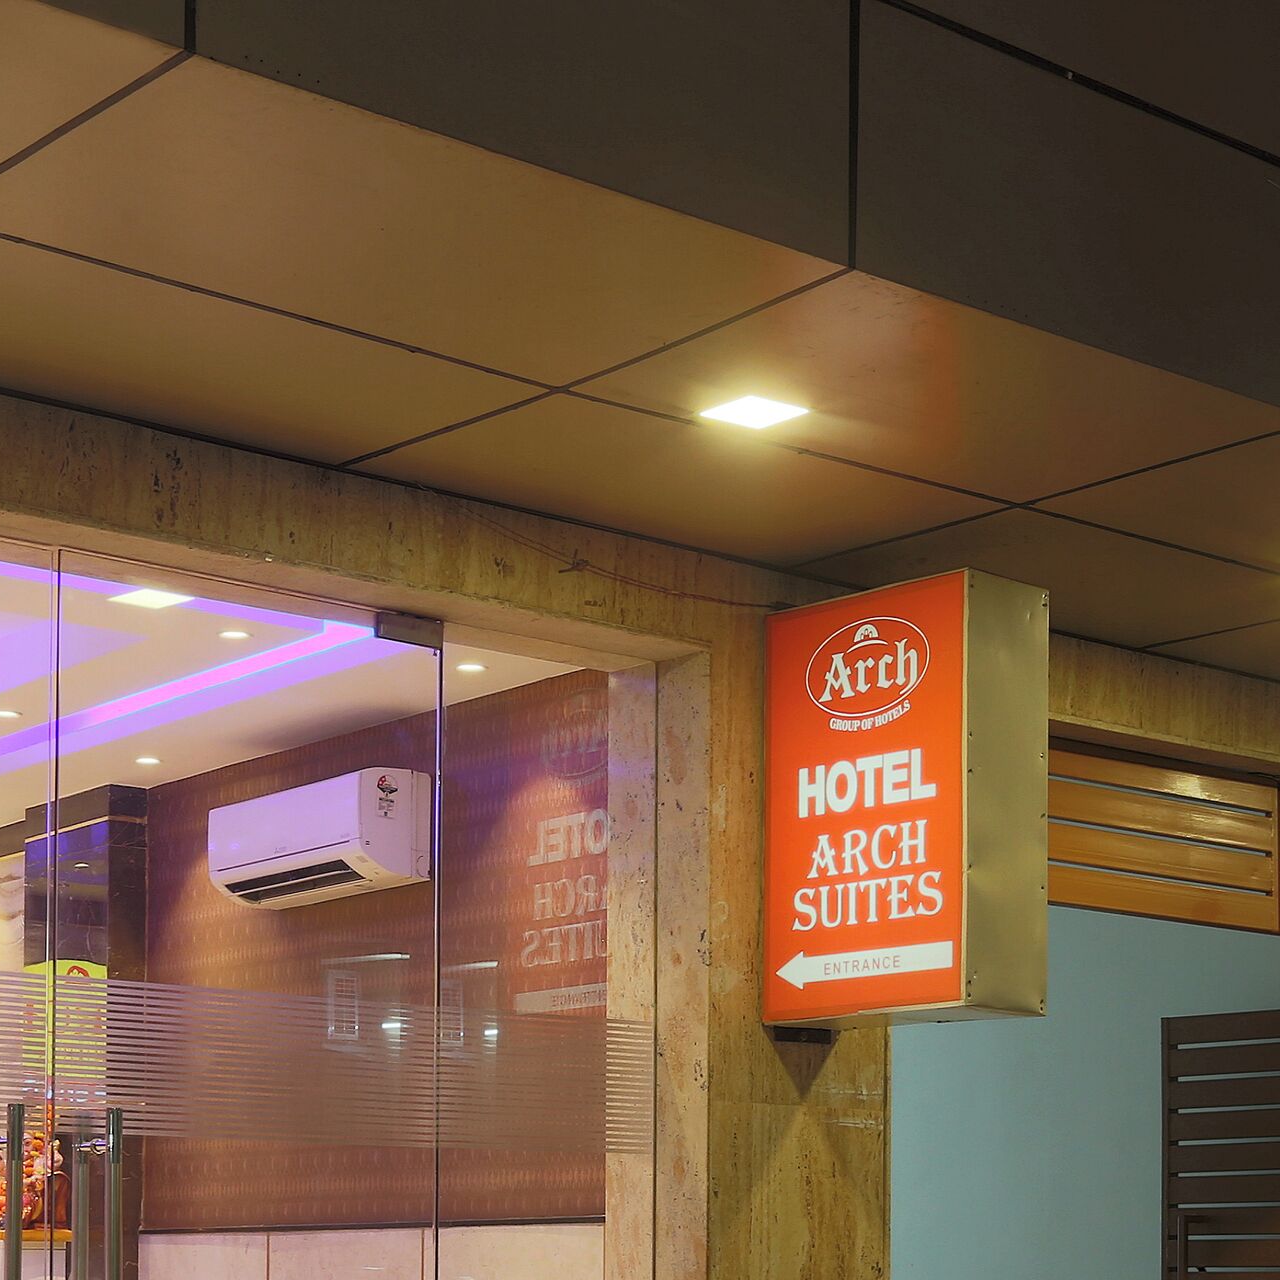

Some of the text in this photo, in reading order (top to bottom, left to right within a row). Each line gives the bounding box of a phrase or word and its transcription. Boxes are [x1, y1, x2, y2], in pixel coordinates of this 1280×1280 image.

[818, 638, 918, 703] Arch
[830, 699, 910, 731] GROUP OF HOTELS
[798, 748, 937, 819] HOTEL
[806, 819, 928, 879] ARCH
[791, 870, 943, 931] SUITES
[823, 955, 902, 976] ENTRANCE
